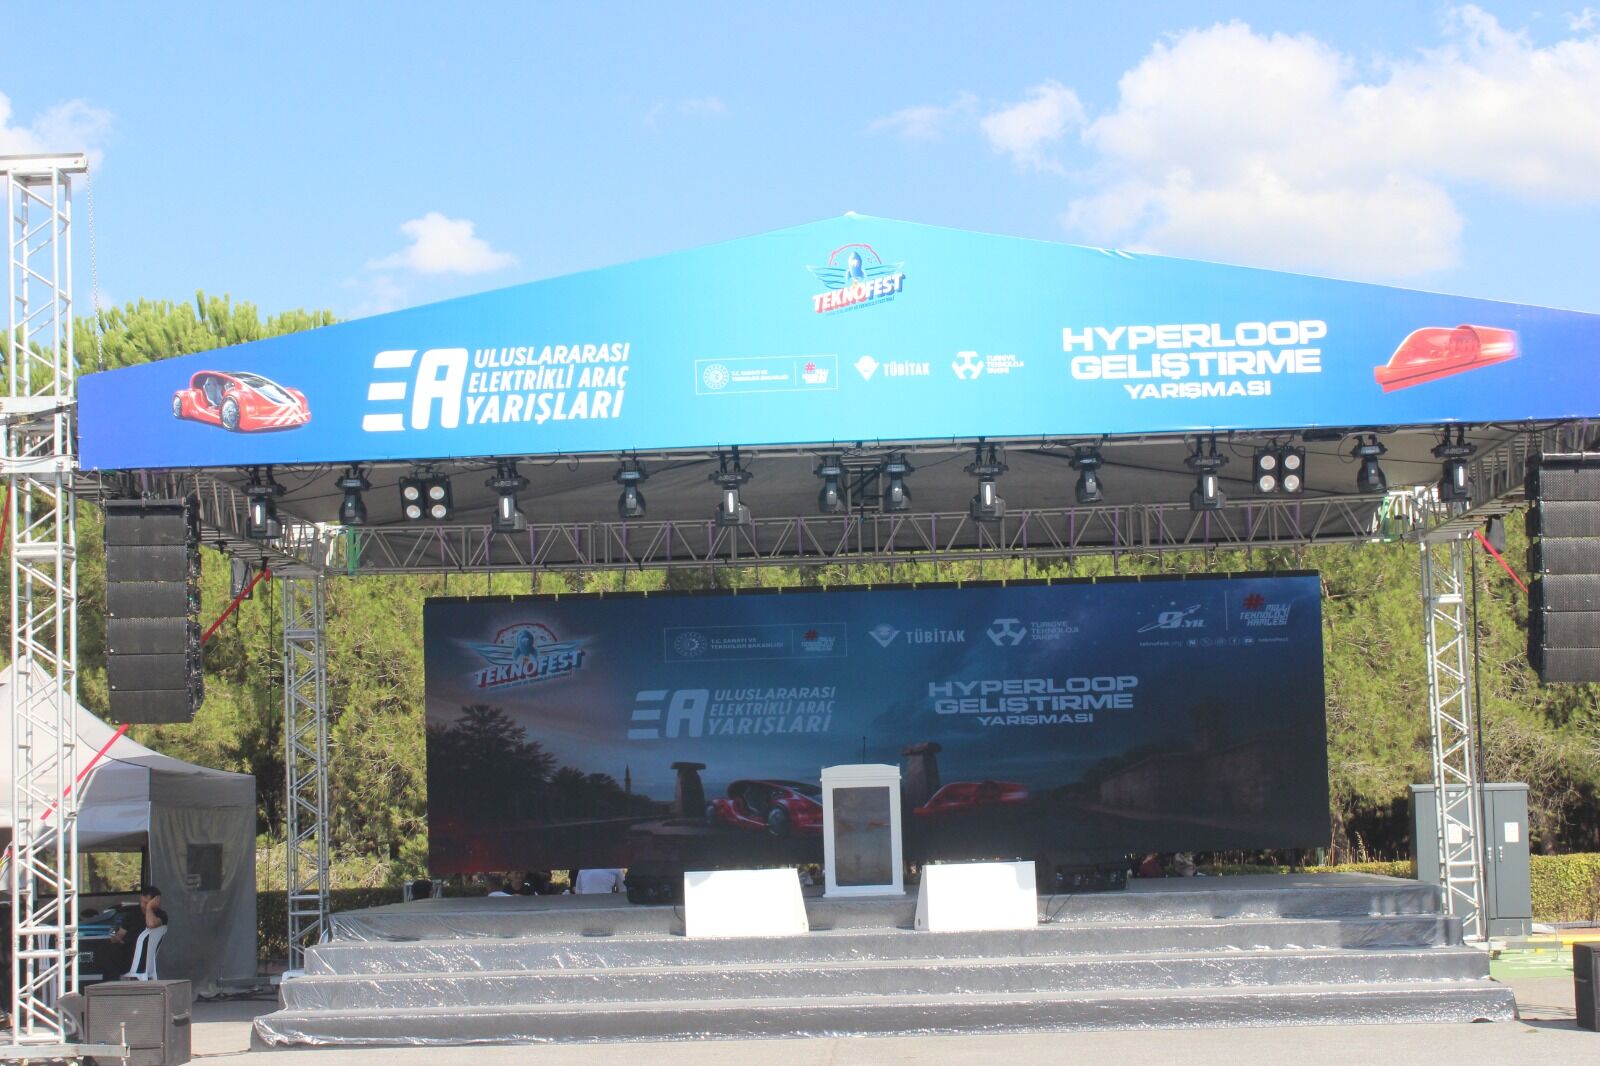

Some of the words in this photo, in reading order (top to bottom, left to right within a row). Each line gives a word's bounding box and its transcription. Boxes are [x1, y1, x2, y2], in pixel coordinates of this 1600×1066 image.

[812, 271, 906, 314] TEKNOFEST
[1062, 320, 1328, 352] HYPERLOOP
[474, 342, 630, 368] ULUSLARARASI
[468, 364, 575, 394] ELEKTRİKLİ
[577, 365, 630, 390] ARAÇ
[882, 360, 931, 377] TÜBİTAK
[1123, 380, 1271, 400] YARIŞMASI
[466, 390, 625, 425] YARIŞLARI
[906, 628, 965, 644] TÜBİTAK
[474, 648, 586, 688] TEKNOFEST
[714, 686, 836, 701] ULUSLARARASI
[928, 676, 1139, 697] HYPERLOOP
[710, 700, 792, 717] ELEKTRİKLİ
[708, 715, 832, 736] YARIŞLARI
